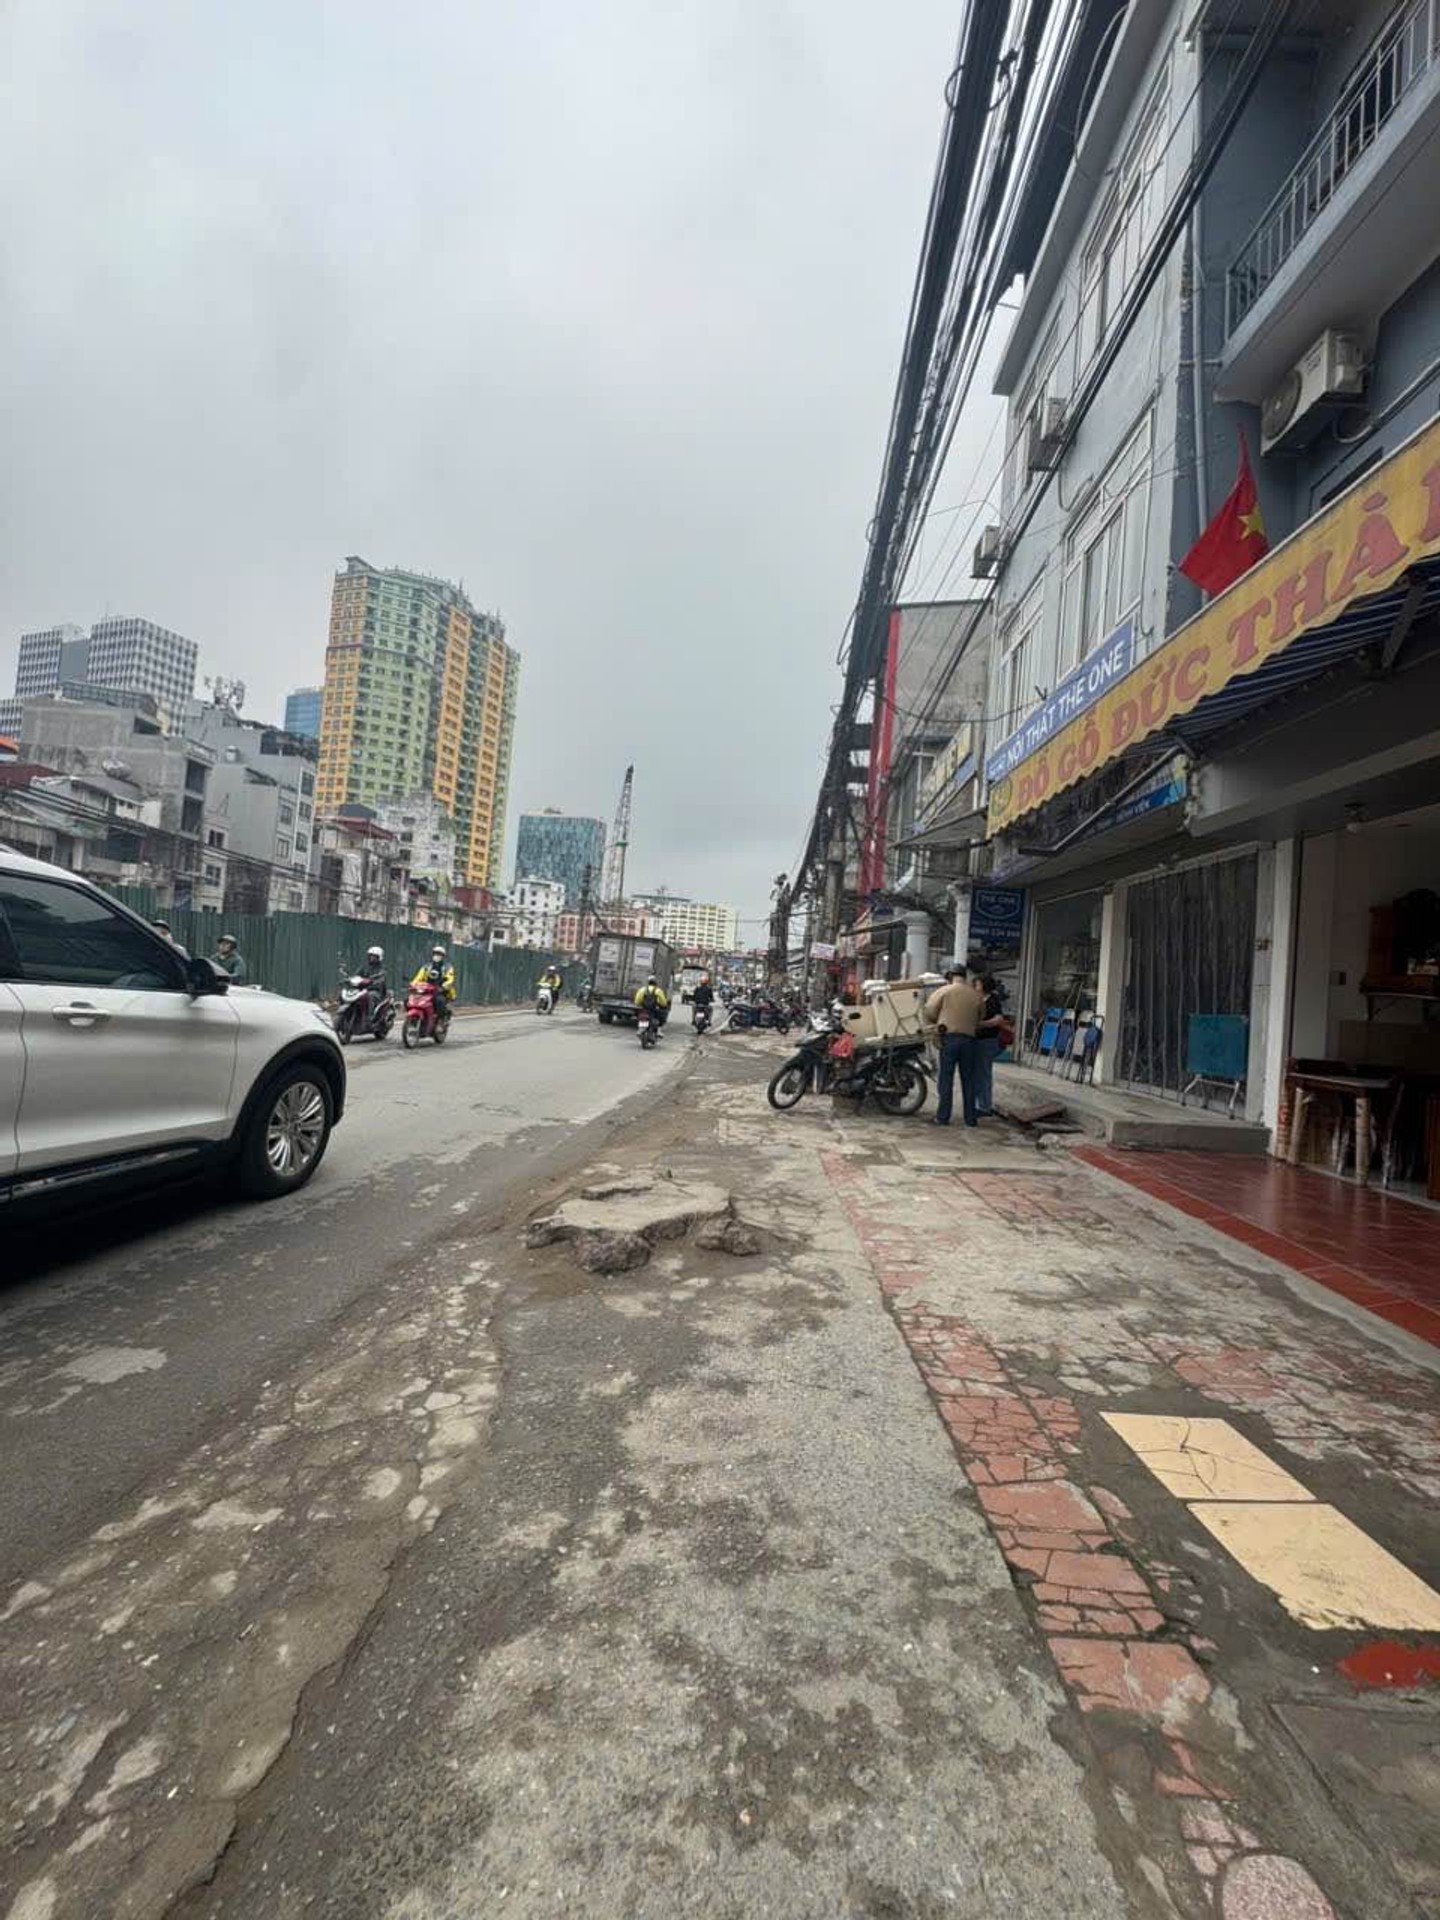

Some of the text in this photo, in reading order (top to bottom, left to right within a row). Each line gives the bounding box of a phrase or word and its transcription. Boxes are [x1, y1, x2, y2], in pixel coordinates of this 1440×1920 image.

[1017, 748, 1050, 811] ĐỒ
[1057, 709, 1100, 781] GỖ
[1111, 646, 1210, 748] ĐỨC
[1226, 460, 1440, 668] THÀ
[1058, 676, 1087, 720] THE
[1088, 640, 1124, 693] ONE
